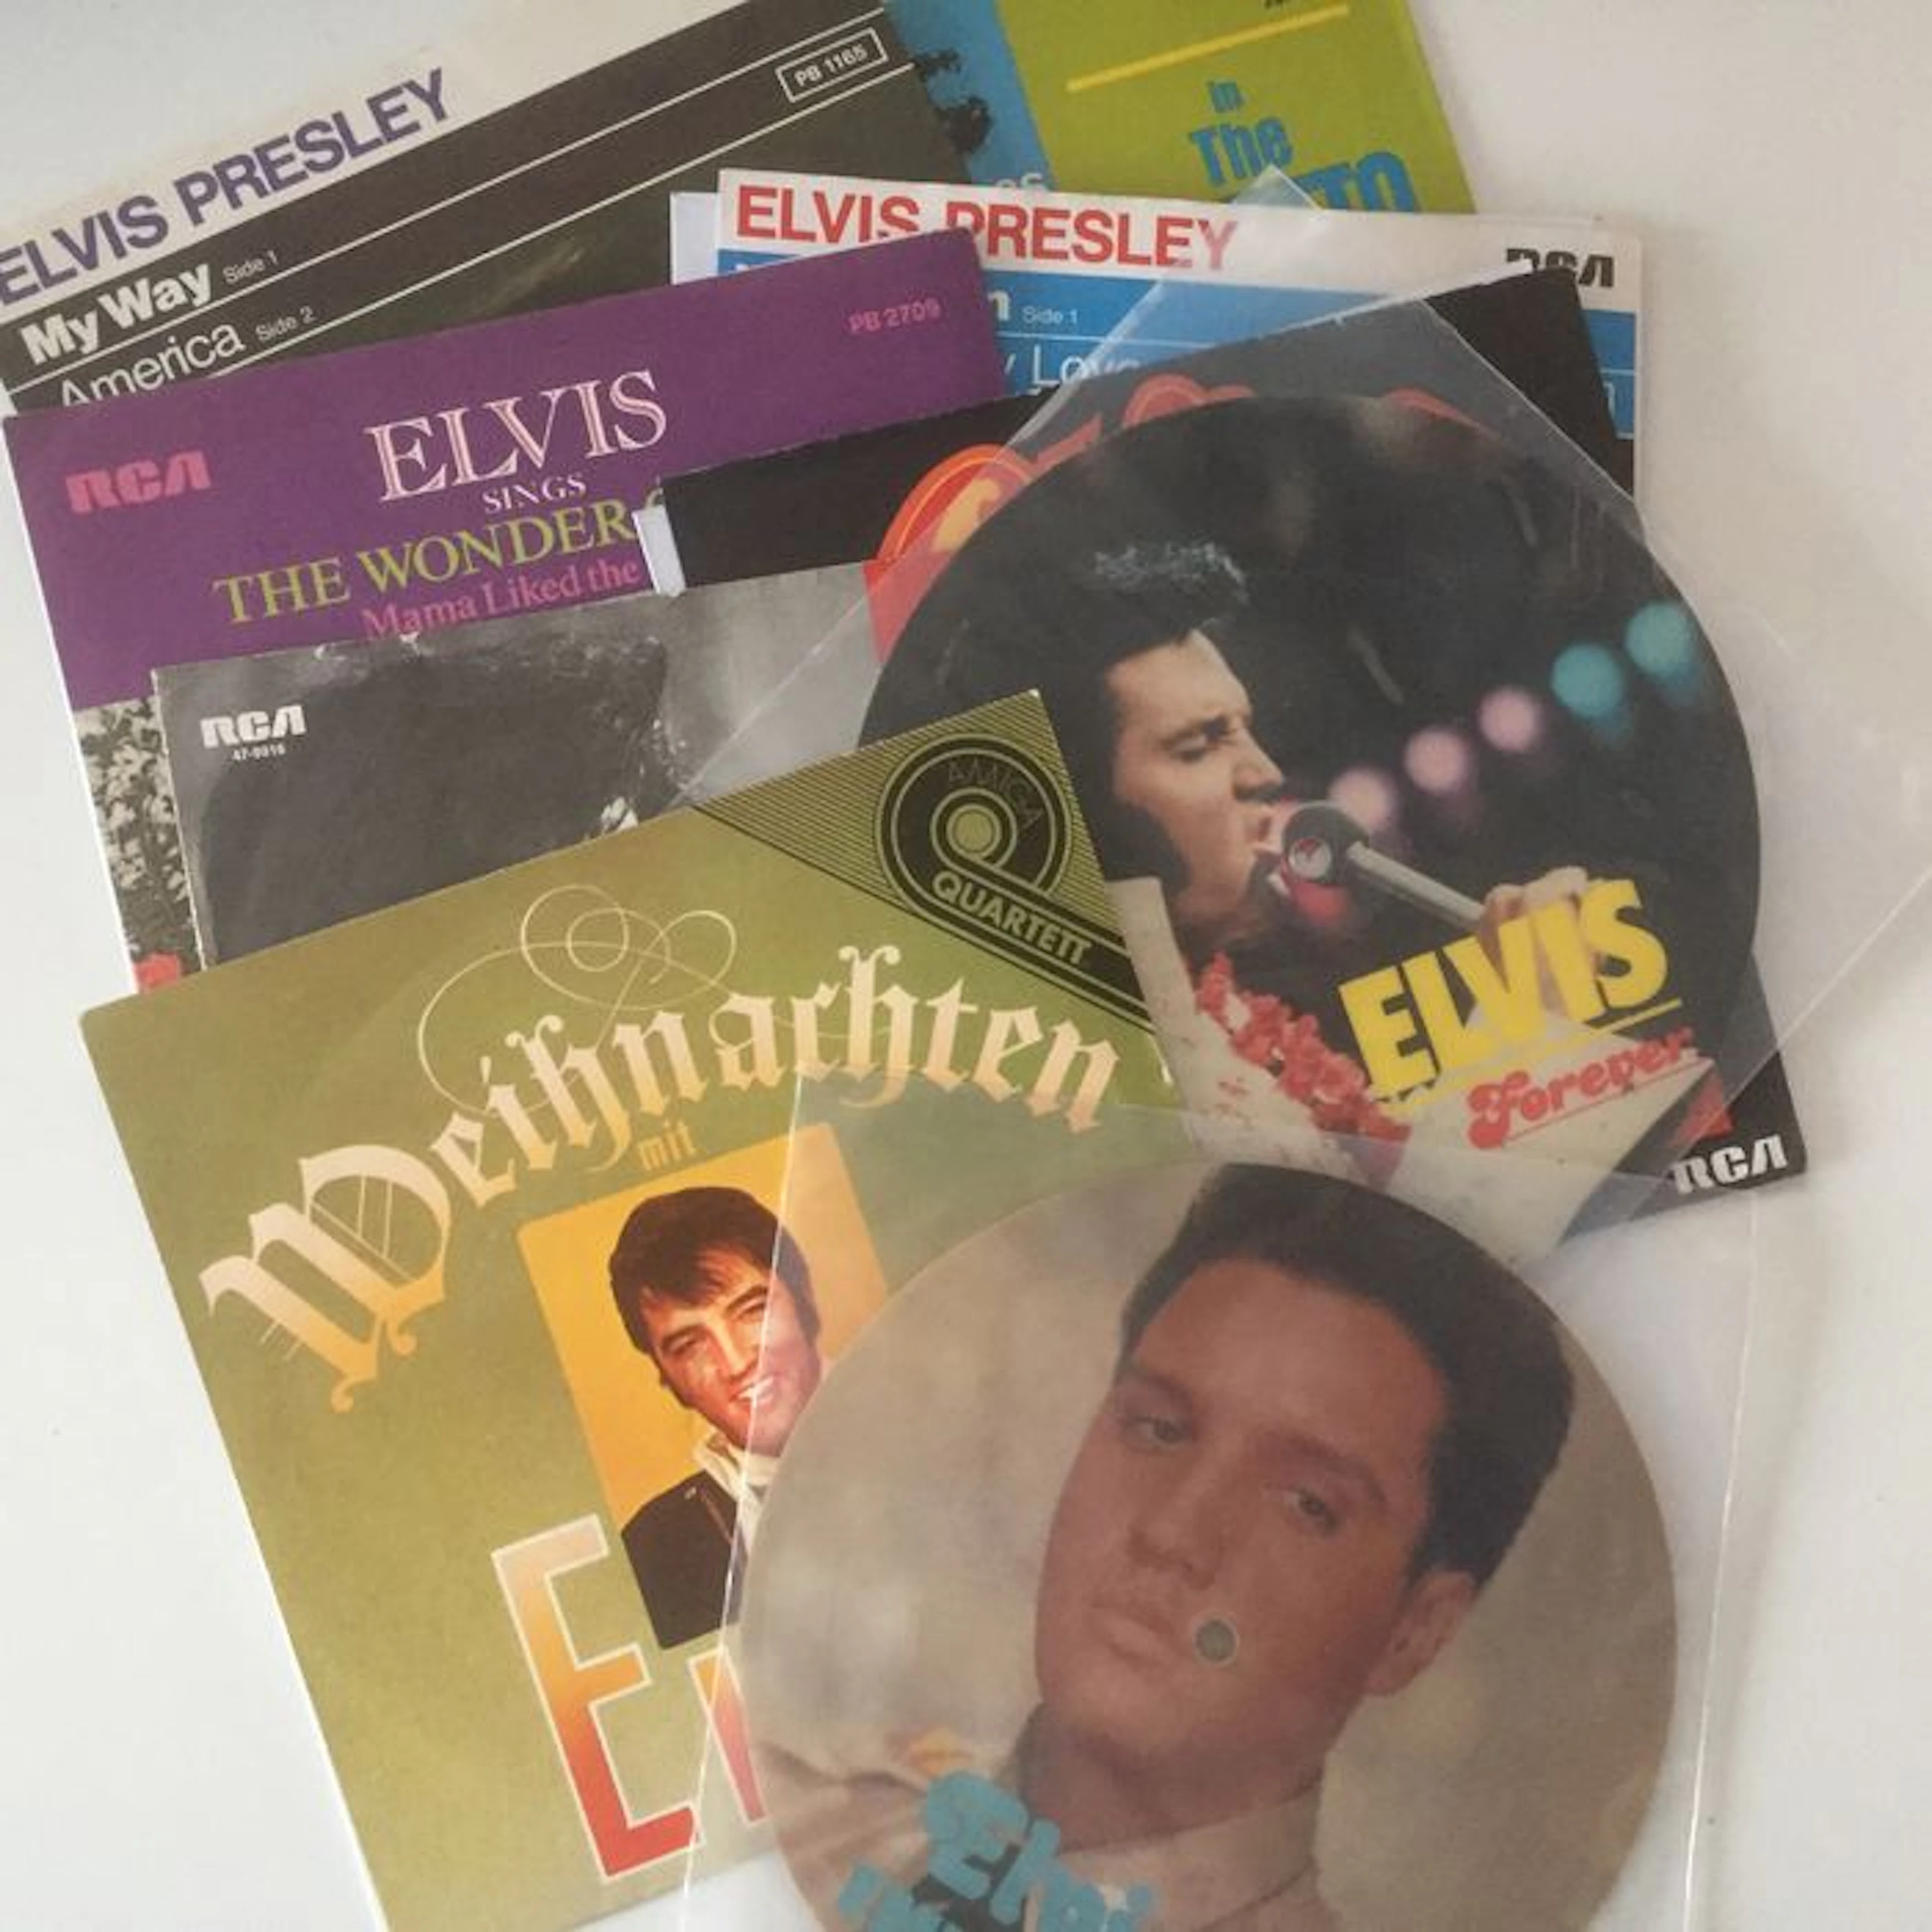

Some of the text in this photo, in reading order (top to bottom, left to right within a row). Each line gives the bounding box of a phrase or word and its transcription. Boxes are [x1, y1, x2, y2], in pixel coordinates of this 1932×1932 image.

[794, 65, 823, 87] PB
[0, 67, 448, 302] ELVIS PRESLEY
[1189, 117, 1292, 187] The
[737, 185, 1237, 270] ELVIS PRESLEY
[20, 306, 102, 366] My
[97, 263, 212, 330] Way
[223, 259, 266, 284] Side
[848, 297, 941, 335] PB 2709
[1023, 305, 1063, 324] Side
[61, 305, 315, 407] America Side 2
[363, 369, 667, 502] ELVIS
[65, 450, 212, 515] RCA
[482, 471, 588, 514] SINGS
[212, 499, 639, 624] THE WONDER
[361, 558, 640, 636] Mama Liked the
[200, 705, 306, 749] RCA
[932, 870, 1092, 965] QUARTETT
[1337, 878, 1668, 1093] ELVIS
[1467, 1025, 1698, 1149] Forever
[199, 945, 1119, 1412] Weihnachten
[636, 1120, 697, 1171] mit
[1671, 1134, 1787, 1193] RCA
